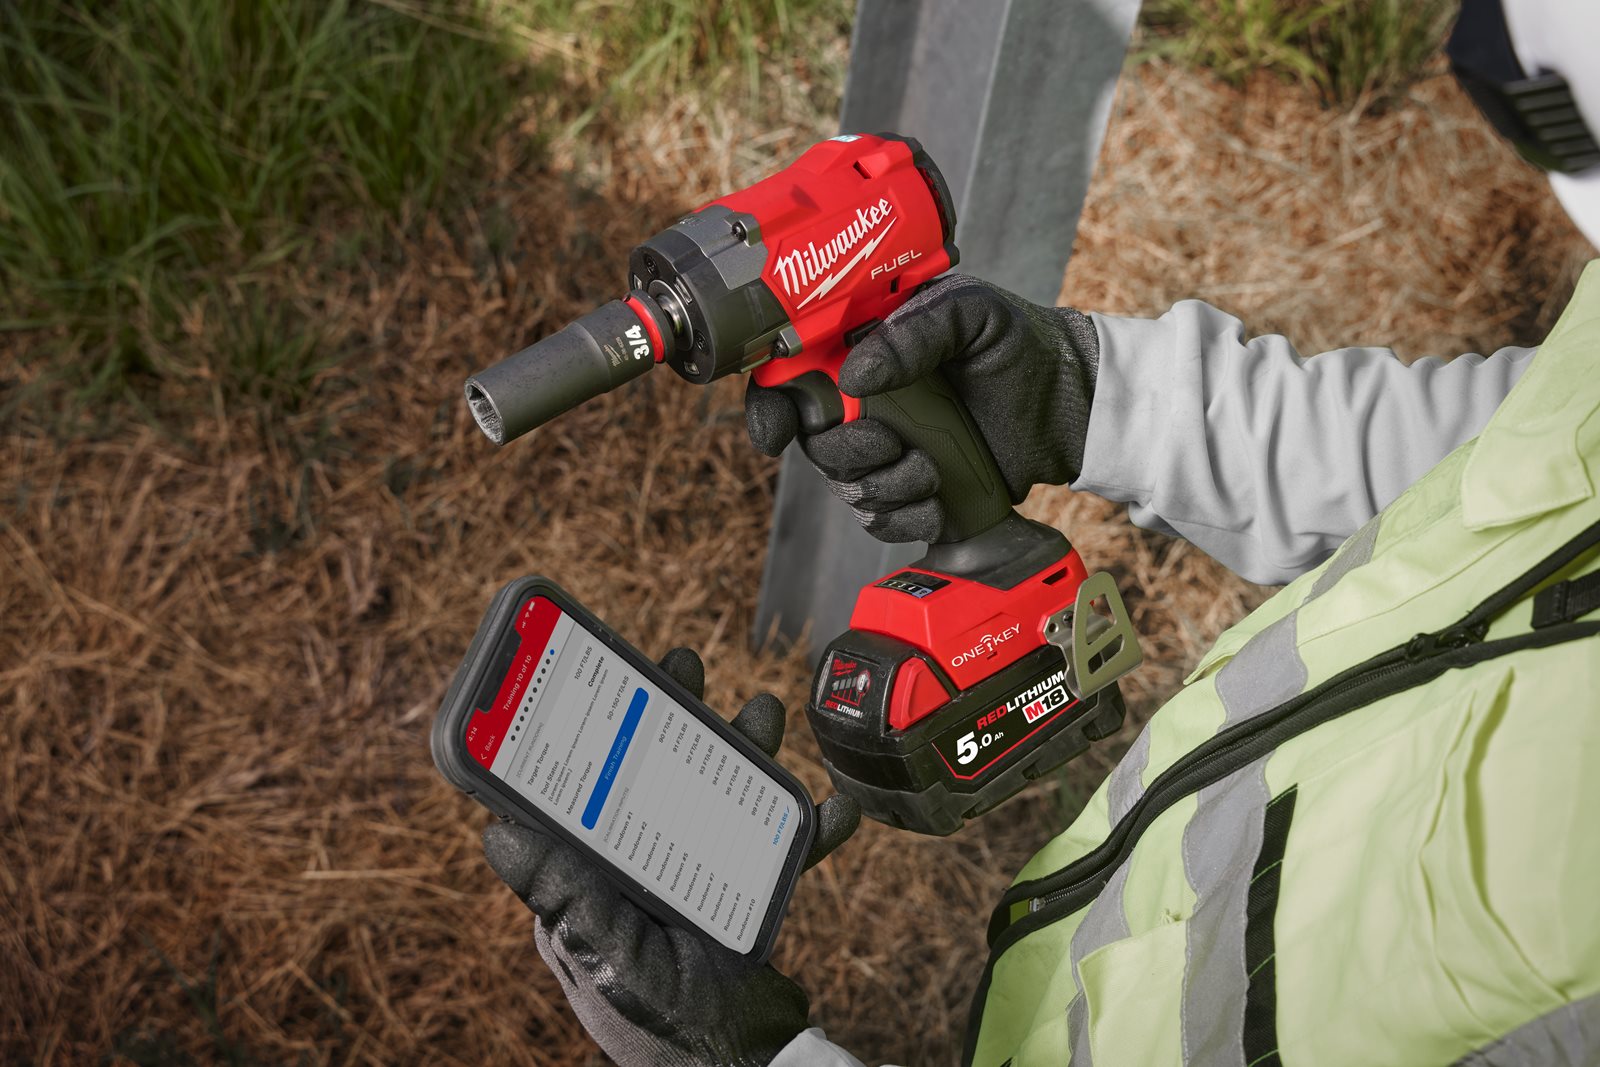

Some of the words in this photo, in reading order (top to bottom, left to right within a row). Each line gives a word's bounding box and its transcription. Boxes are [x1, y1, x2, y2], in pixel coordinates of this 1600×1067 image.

[774, 198, 892, 297] Milwaukee
[871, 250, 922, 280] FUEL
[625, 325, 650, 360] 3/4
[574, 667, 582, 680] 100
[579, 645, 592, 668] FT/LBS
[587, 655, 605, 688] Complete
[502, 682, 520, 712] Training
[516, 672, 524, 682] 10
[520, 663, 527, 673] of
[524, 653, 532, 664] 10
[616, 674, 629, 698] FT/LBS
[976, 671, 1065, 730] REDLITHIUM
[1024, 690, 1065, 721] M18
[484, 733, 496, 752] Back
[658, 732, 665, 743] 90
[672, 743, 678, 753] 91
[957, 731, 992, 765] 5.0
[994, 731, 1004, 742] Ah
[526, 764, 540, 787] Target
[536, 741, 550, 765] Torque
[540, 780, 550, 796] Tool
[546, 759, 559, 781] Status
[685, 754, 692, 765] 92
[565, 782, 583, 815] Measured
[579, 760, 593, 783] Torque
[711, 775, 718, 786] 94
[613, 819, 629, 851] Rundown
[626, 810, 633, 820] #1
[627, 830, 643, 861] Rundown
[640, 820, 647, 830] #2
[772, 832, 780, 846] 100
[642, 840, 657, 871] Rundown
[654, 831, 661, 841] #3
[655, 851, 671, 882] Rundown
[667, 841, 674, 851] #4
[669, 861, 685, 892] Rundown
[681, 851, 688, 862] #5
[683, 871, 698, 902] Rundown
[695, 862, 702, 872] #6
[696, 881, 711, 911] Rundown
[708, 872, 714, 882] #7
[710, 891, 724, 922] Rundown
[721, 882, 728, 892] #8
[723, 901, 737, 931] Rundown
[734, 891, 741, 901] #9
[736, 911, 750, 941] Rundown
[747, 898, 755, 911] #10
